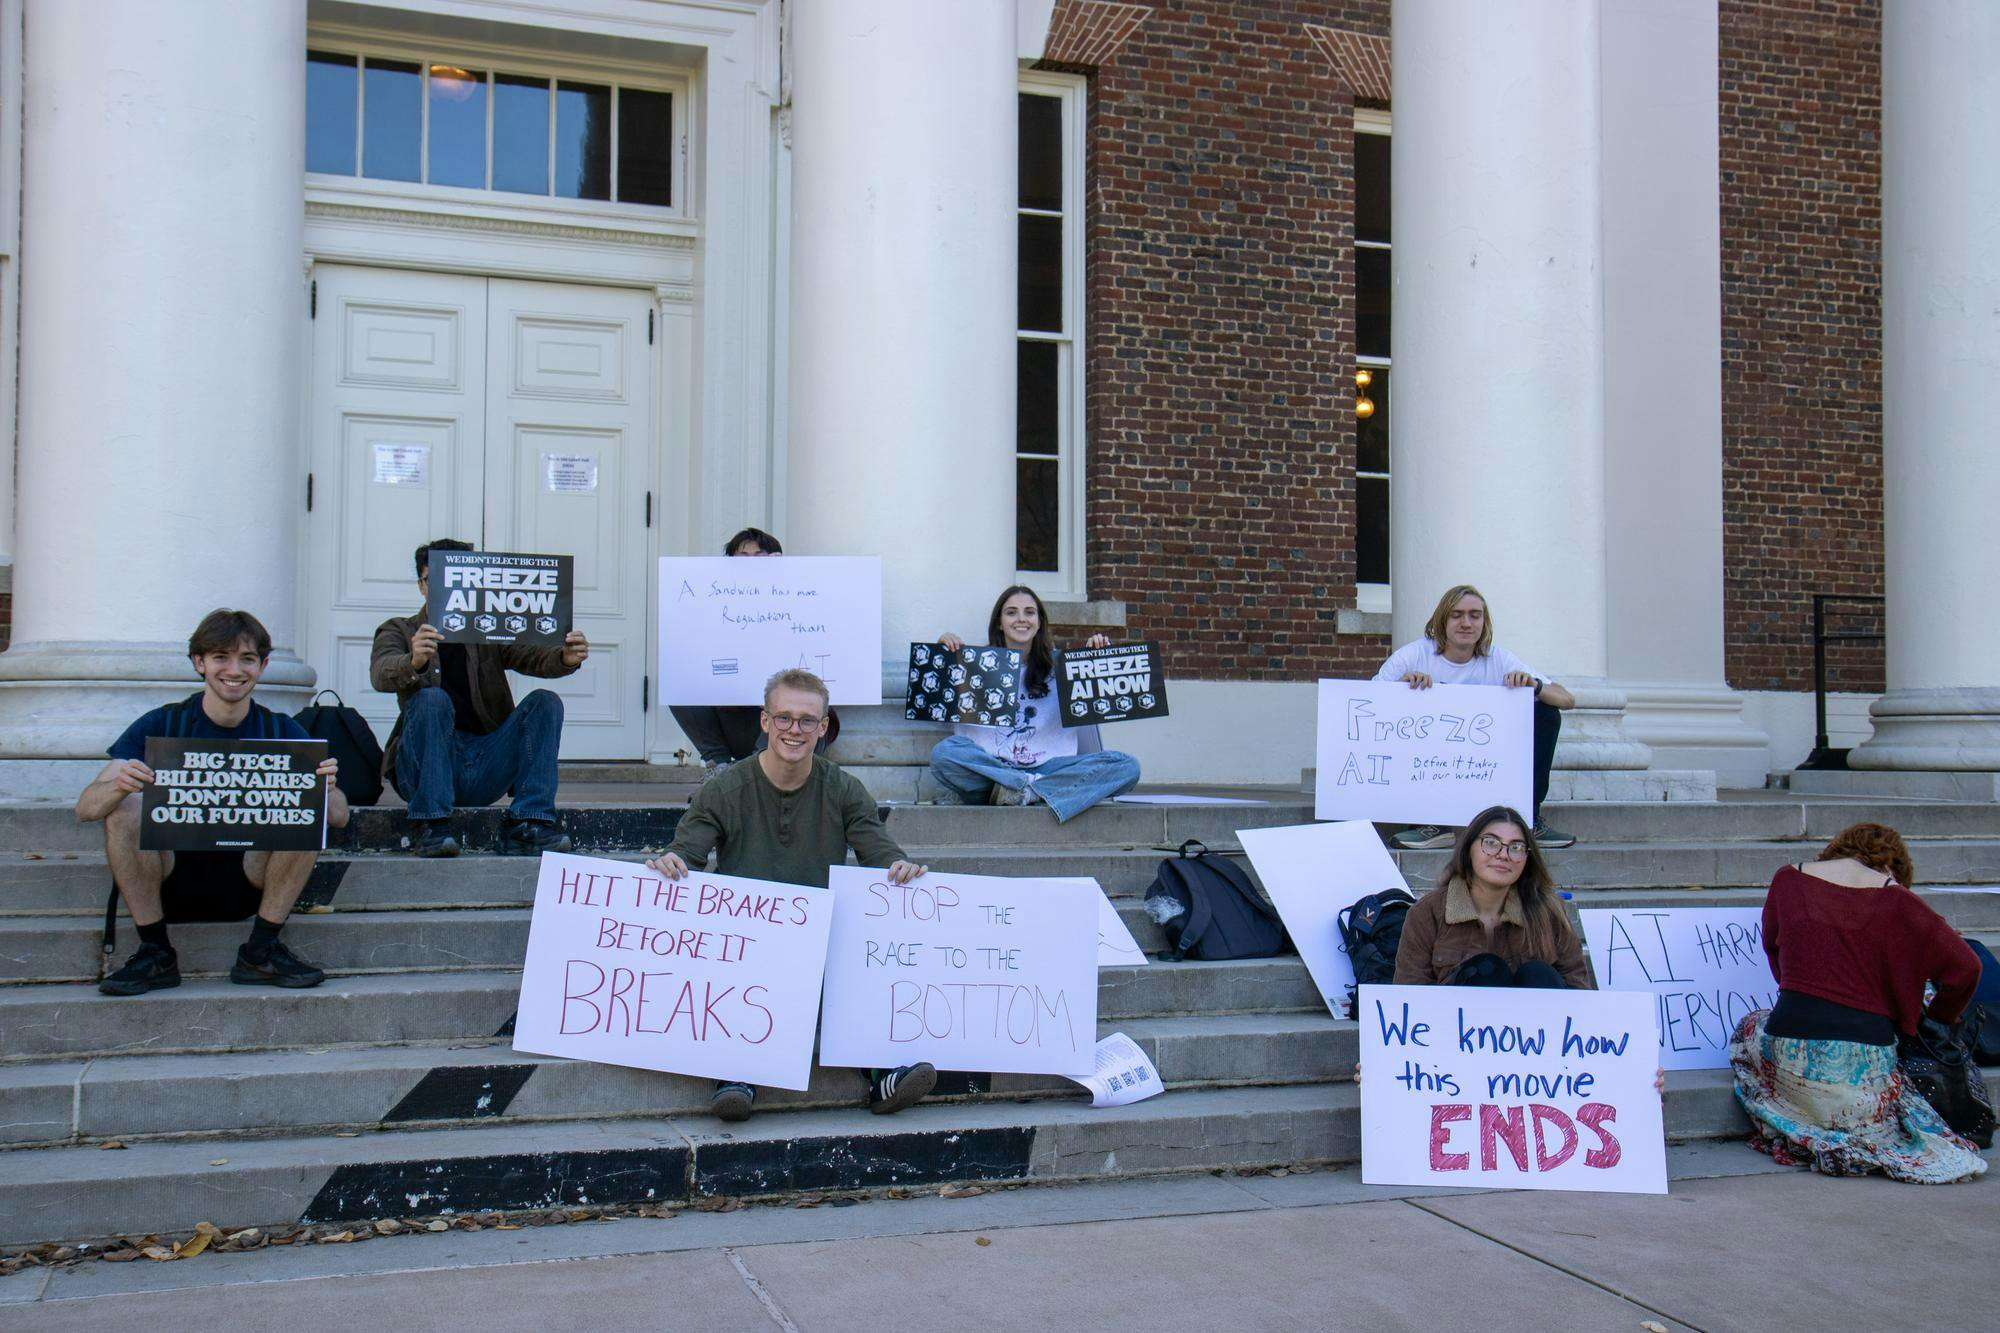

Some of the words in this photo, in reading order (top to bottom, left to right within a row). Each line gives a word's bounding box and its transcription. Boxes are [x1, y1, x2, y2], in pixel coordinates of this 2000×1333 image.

[446, 555, 461, 563] WE
[461, 556, 492, 564] DIDN'T
[492, 557, 520, 566] ELECT
[535, 559, 558, 567] TECH
[444, 566, 558, 591] FREEZE
[679, 580, 695, 601] A
[708, 580, 760, 598] Sandwich
[445, 589, 477, 612] AI
[484, 590, 556, 614] NOW
[722, 605, 792, 630] Regulation
[791, 622, 826, 634] than
[1065, 654, 1151, 680] FREEZE
[1071, 679, 1094, 700] AI
[1098, 674, 1151, 697] NOW
[1347, 698, 1493, 745] Freeze
[183, 752, 226, 769] BIG
[229, 753, 291, 770] TECH
[1337, 752, 1393, 785] AI
[1413, 755, 1448, 768] Before
[1452, 755, 1464, 769] it
[154, 769, 316, 789] BILLIONAIRES
[1411, 771, 1425, 781] all
[167, 788, 243, 806] DON'T
[244, 791, 302, 807] OWN
[151, 807, 208, 824] OUR
[208, 808, 316, 825] FUTURES
[558, 868, 623, 907] HIT
[632, 876, 690, 913] THE
[697, 884, 809, 926] BRAKES
[865, 882, 960, 922] STOP
[978, 905, 1016, 925] THE
[596, 917, 713, 959] BEFORE
[717, 934, 757, 962] IT
[1606, 914, 1695, 986] AI
[1695, 922, 1765, 970] HARM
[866, 940, 923, 968] RACE
[934, 946, 967, 969] TO
[976, 948, 1021, 970] THE
[560, 960, 773, 1044] BREAKS
[889, 980, 1076, 1053] BOTTOM
[1376, 999, 1431, 1047] We
[1458, 1007, 1546, 1056] know
[1561, 1016, 1630, 1058] how
[1395, 1061, 1461, 1097] this
[1487, 1066, 1596, 1099] movie
[1429, 1102, 1622, 1173] ENDS
